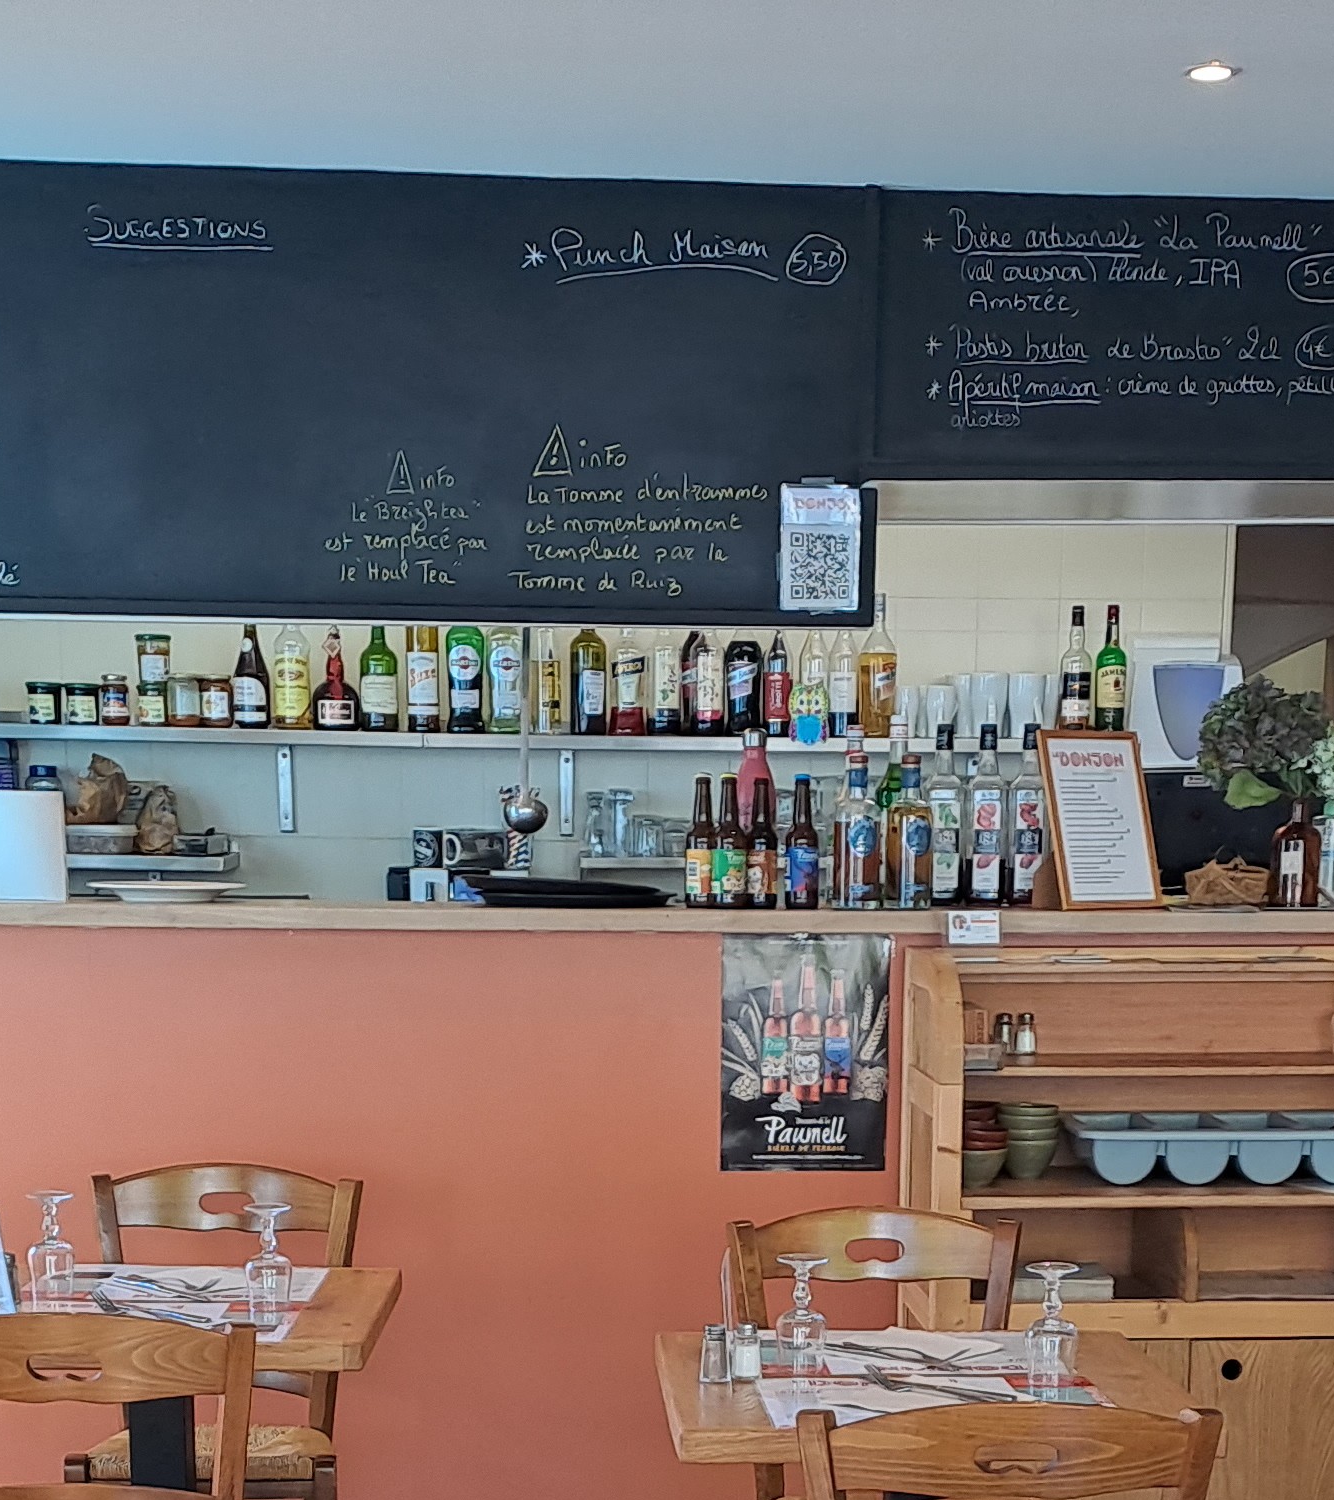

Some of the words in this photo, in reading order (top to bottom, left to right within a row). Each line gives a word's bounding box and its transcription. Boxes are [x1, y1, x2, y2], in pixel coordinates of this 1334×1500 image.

[84, 203, 266, 241] SUGGESTIONS
[948, 207, 1013, 253] Bière
[1025, 220, 1145, 249] artisanale
[551, 228, 653, 271] Punch
[670, 230, 769, 262] Maison
[792, 250, 841, 276] 5,50
[1189, 258, 1242, 289] IPA
[1024, 376, 1101, 398] maison
[1118, 373, 1170, 396] crème
[1178, 373, 1197, 396] de
[527, 483, 551, 505] La
[554, 486, 625, 503] Tomme
[525, 513, 557, 535] est
[324, 531, 355, 552] est
[456, 538, 489, 557] par
[655, 546, 696, 564] par
[506, 570, 586, 592] Tomme
[1060, 751, 1125, 767] DONJON
